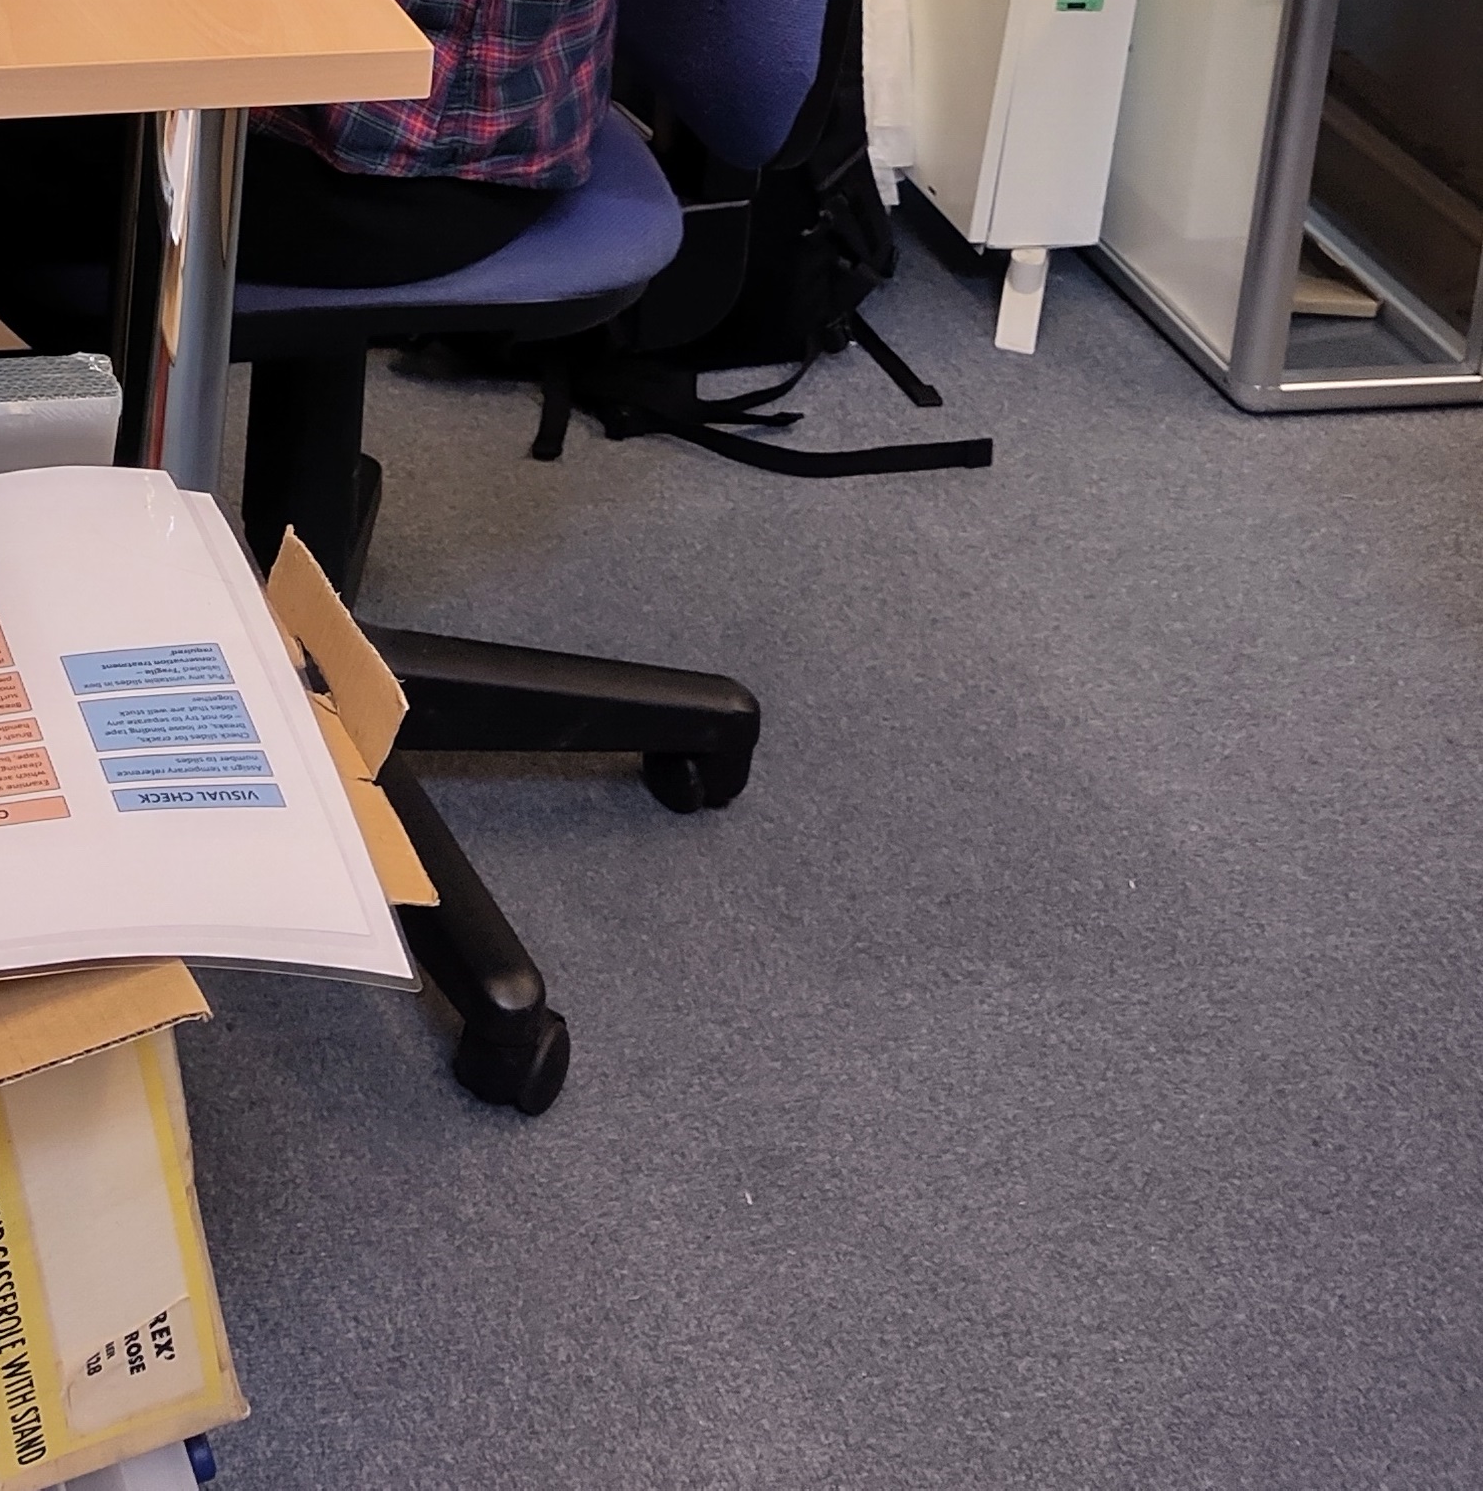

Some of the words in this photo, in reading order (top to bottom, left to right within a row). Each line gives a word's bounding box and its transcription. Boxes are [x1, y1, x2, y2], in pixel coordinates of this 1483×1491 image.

[101, 660, 152, 670] treatment
[153, 656, 217, 667] conservation
[114, 678, 142, 686] slides
[187, 673, 205, 681] any
[191, 694, 234, 703] together
[146, 709, 168, 717] well
[187, 706, 209, 714] that
[210, 704, 237, 713] slides
[105, 719, 125, 727] any
[127, 715, 169, 726] separate
[170, 716, 183, 724] to
[184, 714, 199, 723] try
[220, 714, 234, 722] do
[104, 727, 127, 737] tape
[128, 725, 166, 736] binding
[3, 731, 33, 742] Brush
[173, 735, 188, 743] for
[189, 733, 219, 741] slides
[220, 732, 250, 740] Check
[175, 757, 205, 765] slides
[219, 755, 259, 764] number
[0, 761, 43, 773] cleaning
[167, 765, 221, 775] temporary
[231, 763, 262, 773] Assign
[15, 770, 46, 780] which
[116, 768, 165, 778] reference
[5, 779, 50, 791] Examine
[137, 792, 194, 804] CHECK
[197, 790, 260, 802] VISUAL
[124, 1330, 146, 1375] ROSE
[1, 1352, 36, 1412] WITH
[11, 1407, 47, 1466] STAND
